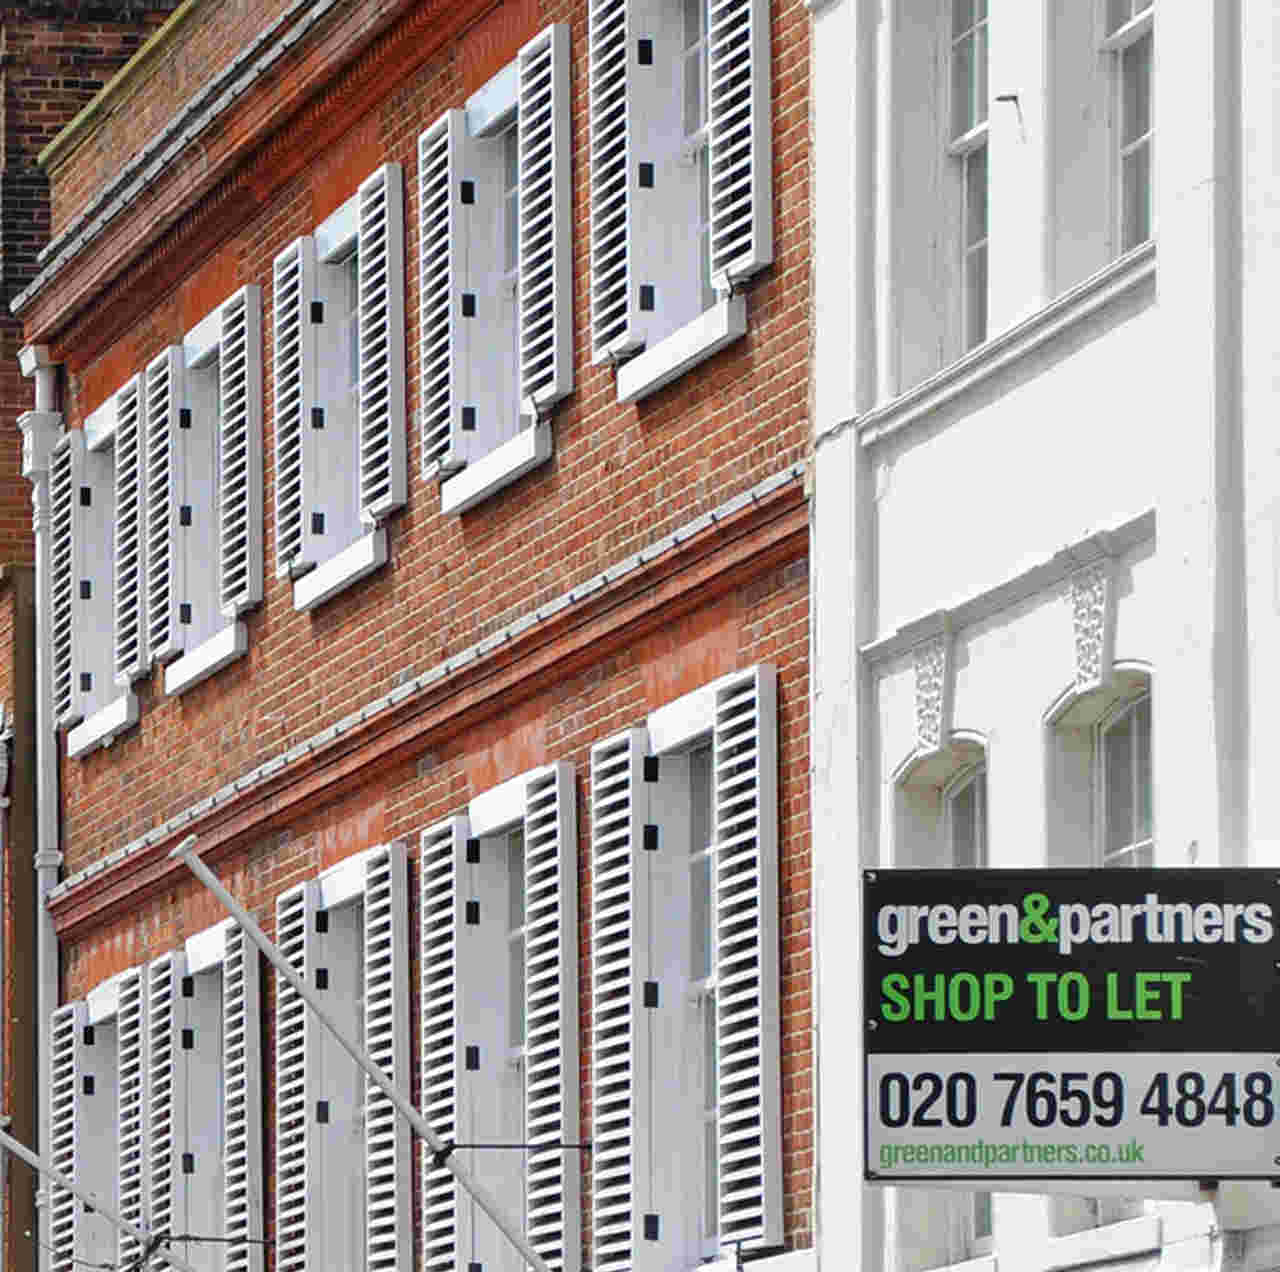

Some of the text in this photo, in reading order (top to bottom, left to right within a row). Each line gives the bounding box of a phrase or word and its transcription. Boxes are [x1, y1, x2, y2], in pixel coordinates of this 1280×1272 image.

[876, 891, 1274, 957] green&partners
[880, 971, 1192, 1022] SHOP TO LET
[878, 1071, 1274, 1128] 020 7659 4848
[878, 1138, 1145, 1169] greenandpartners.co.uk
